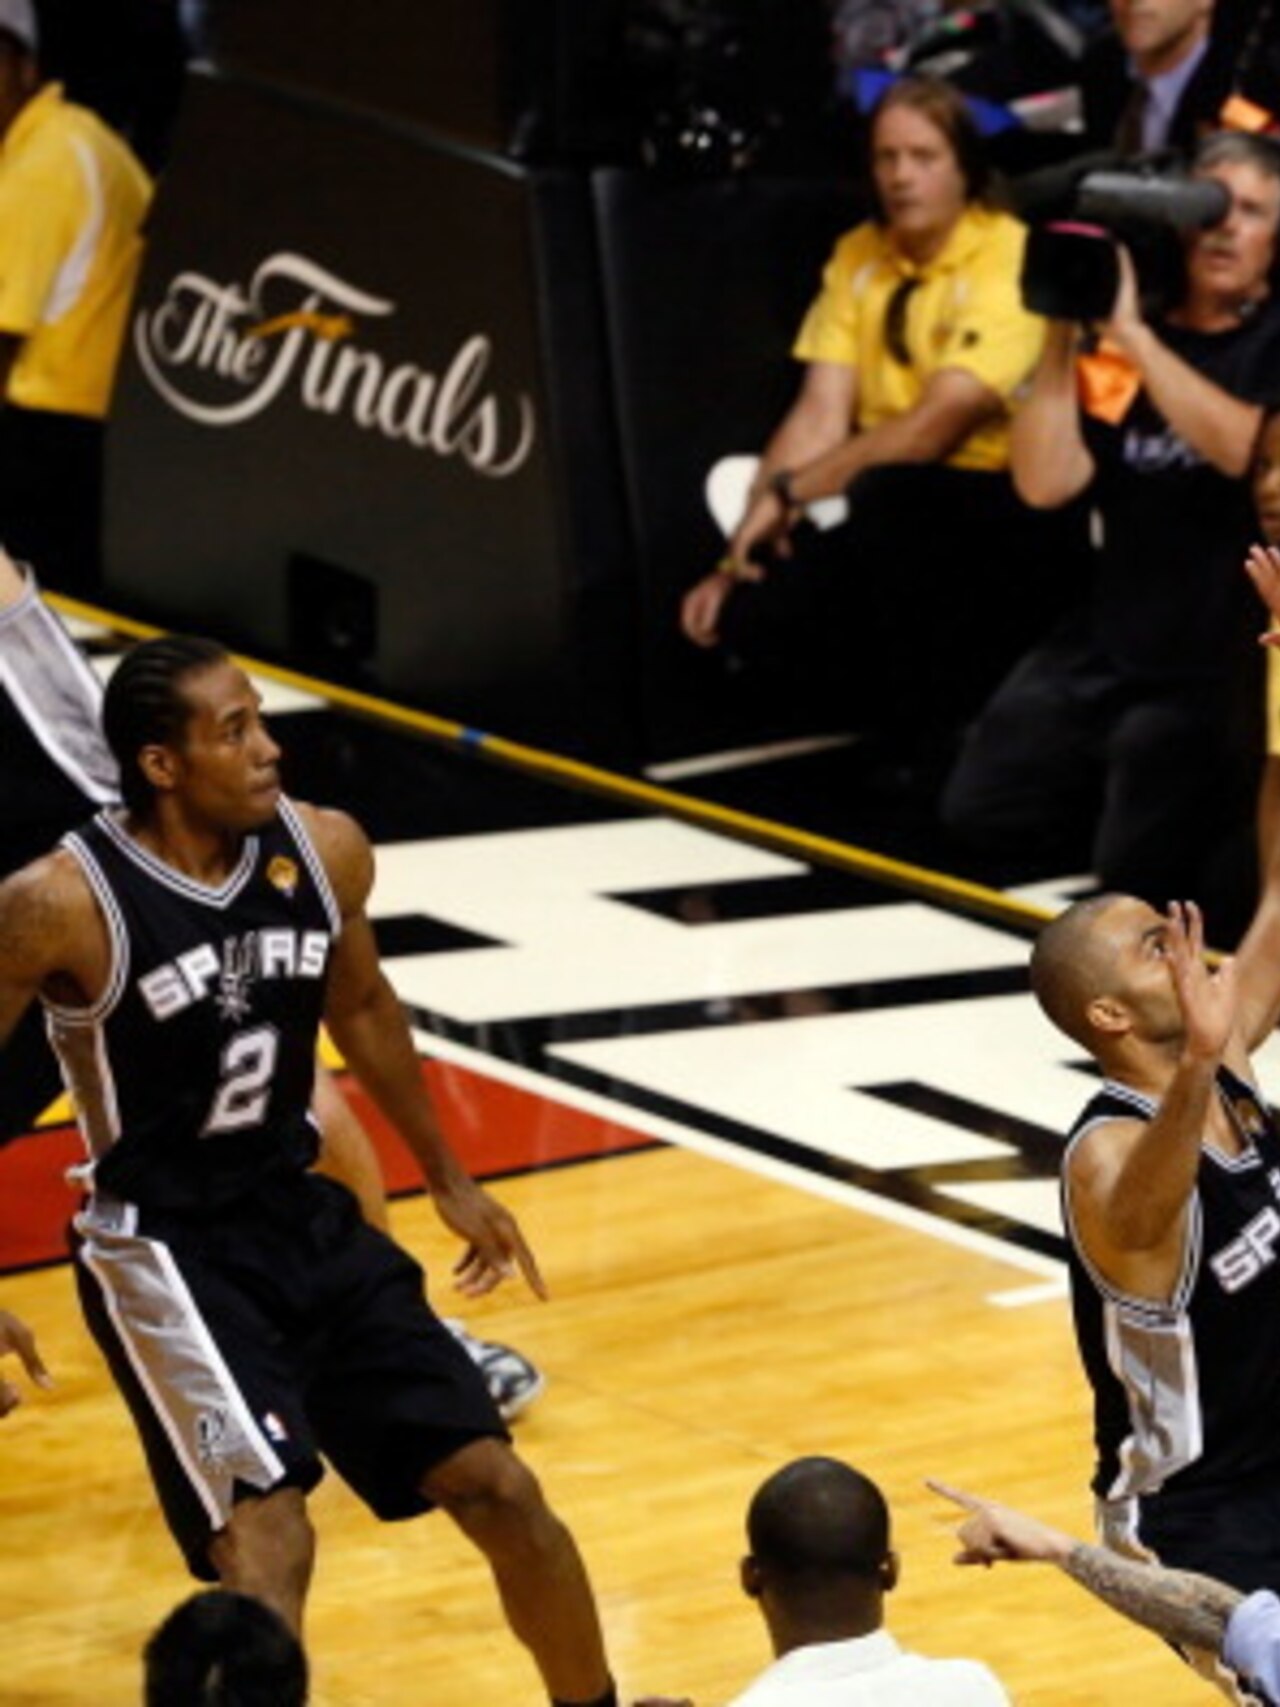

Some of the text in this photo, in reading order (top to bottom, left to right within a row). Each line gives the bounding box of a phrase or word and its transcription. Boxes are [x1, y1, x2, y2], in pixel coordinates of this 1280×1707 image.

[134, 252, 535, 477] The Finals
[138, 927, 330, 1023] SPURS
[199, 1022, 280, 1138] 2
